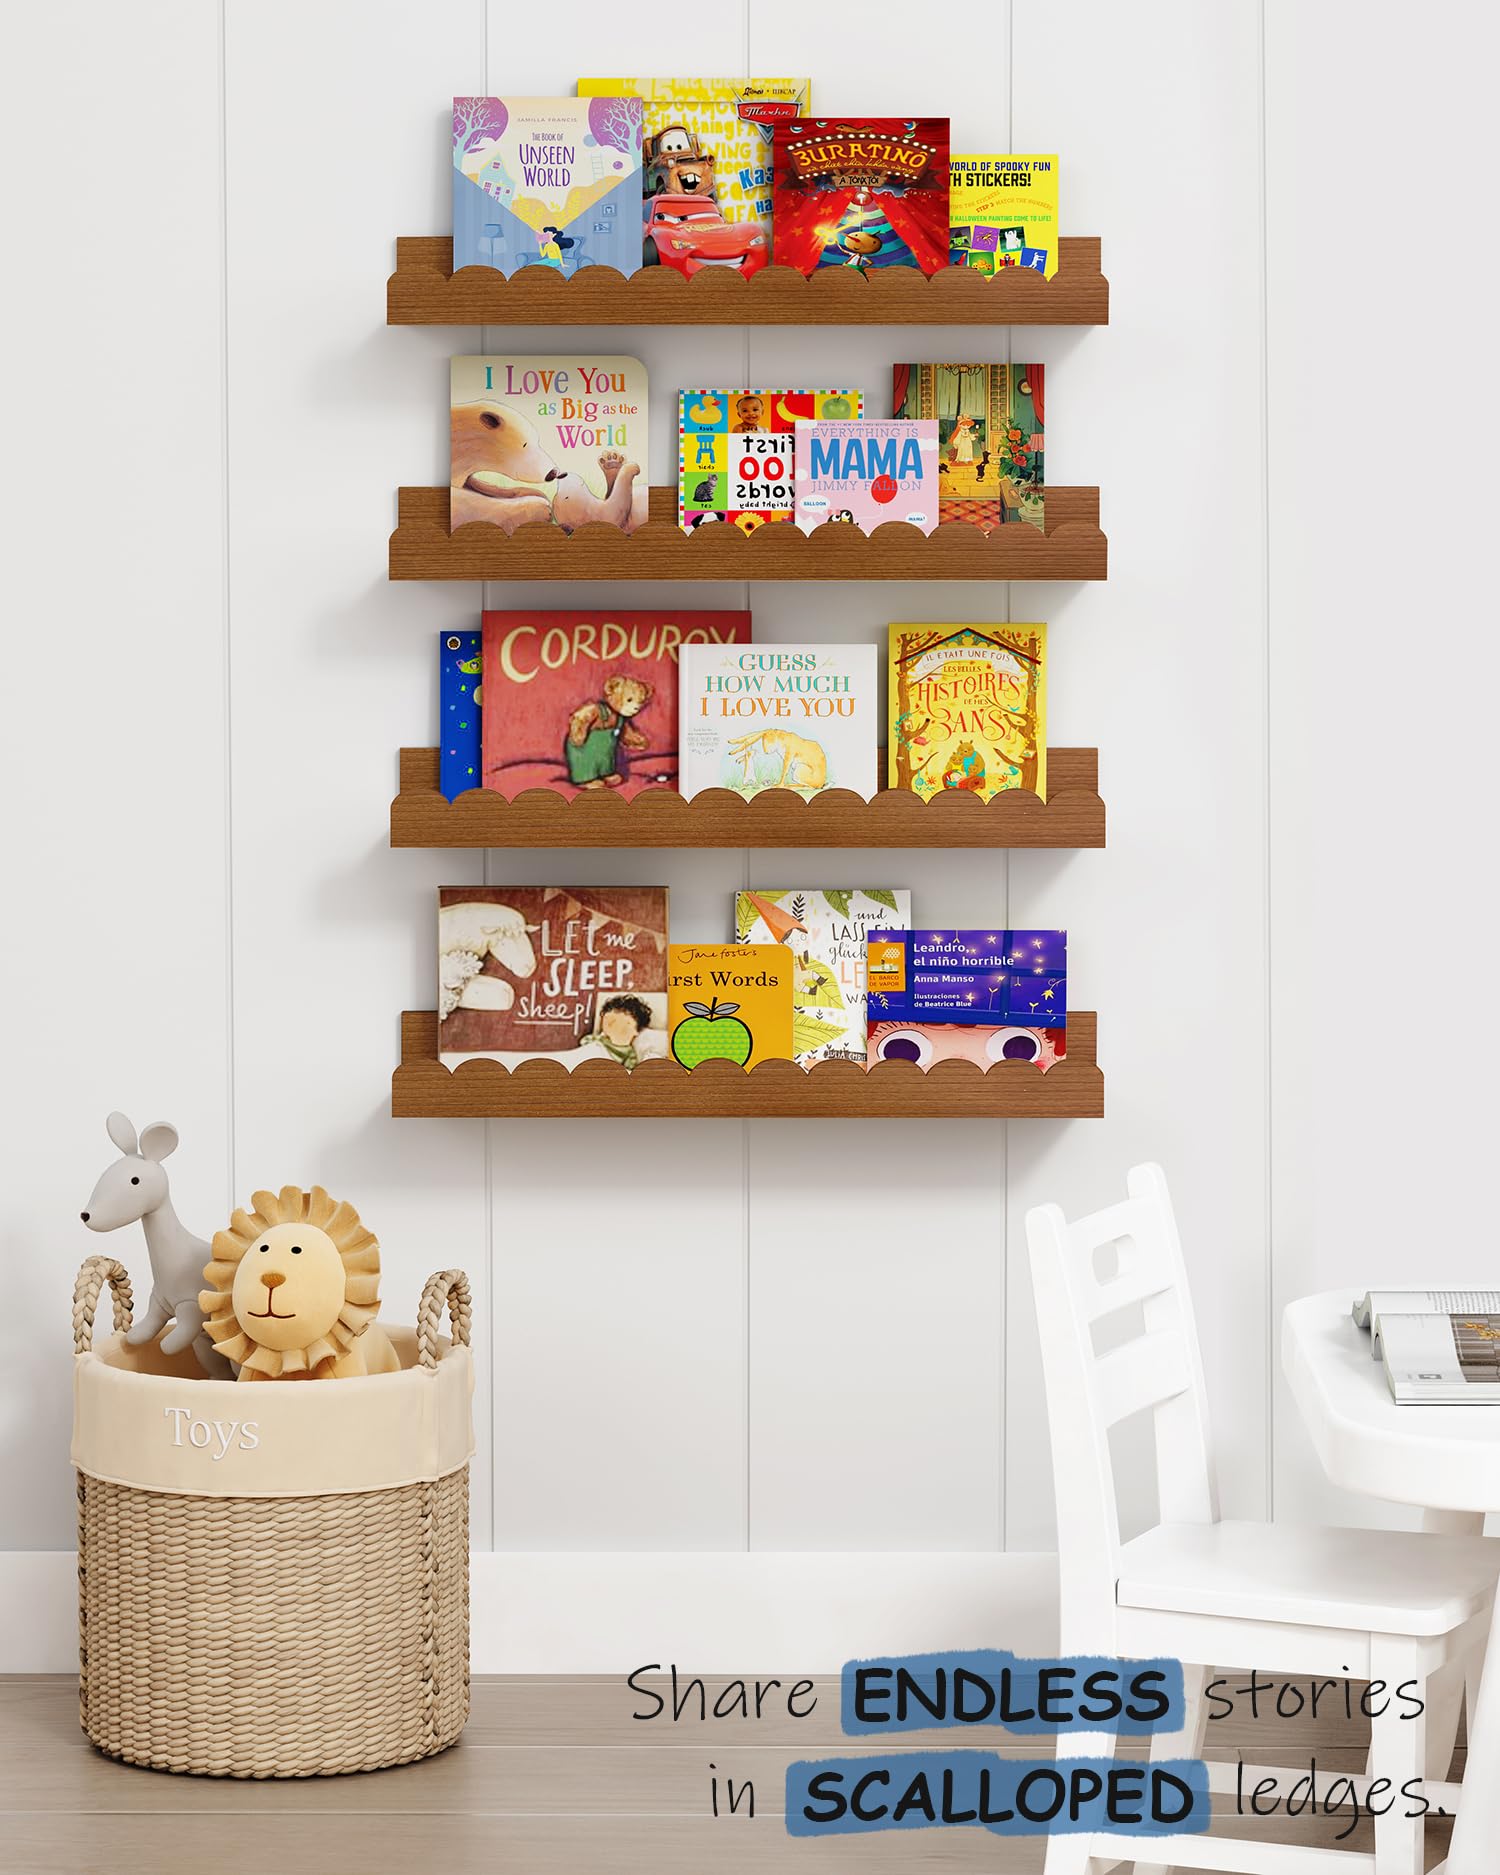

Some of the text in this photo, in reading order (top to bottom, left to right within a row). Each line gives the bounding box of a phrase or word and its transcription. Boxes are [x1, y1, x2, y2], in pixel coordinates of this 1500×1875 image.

[532, 132, 564, 141] THE BOOK OF
[519, 143, 575, 165] UNSEEN
[980, 161, 992, 172] OF
[994, 161, 1030, 172] SPOOKY
[1033, 161, 1051, 172] FUN
[523, 165, 571, 187] WORLD
[965, 172, 1032, 187] STICKERS!
[485, 365, 626, 395] I Love You
[537, 397, 638, 422] as Big as the
[556, 424, 628, 449] World
[811, 428, 919, 437] EVERYTHING IS
[810, 438, 924, 480] MAMA
[811, 480, 921, 493] JIMMY FALLON
[738, 653, 817, 671] GUESS
[967, 650, 988, 658] UNE
[990, 652, 1010, 661] FOIS
[943, 665, 957, 673] LES
[704, 675, 851, 693] HOW MUCH
[918, 672, 1021, 705] HISTOIRES
[700, 697, 856, 717] I LOVE YOU
[952, 709, 1006, 741] ANS
[854, 908, 887, 920] und
[603, 932, 637, 950] me
[832, 922, 865, 942] LASS
[677, 948, 718, 964] Jane
[913, 943, 970, 954] Leandro,
[913, 956, 1014, 966] el niño horrible
[542, 958, 634, 998] SLEEP,
[709, 971, 779, 987] Words
[913, 975, 975, 983] Anna Manso
[163, 1407, 260, 1461] Toys
